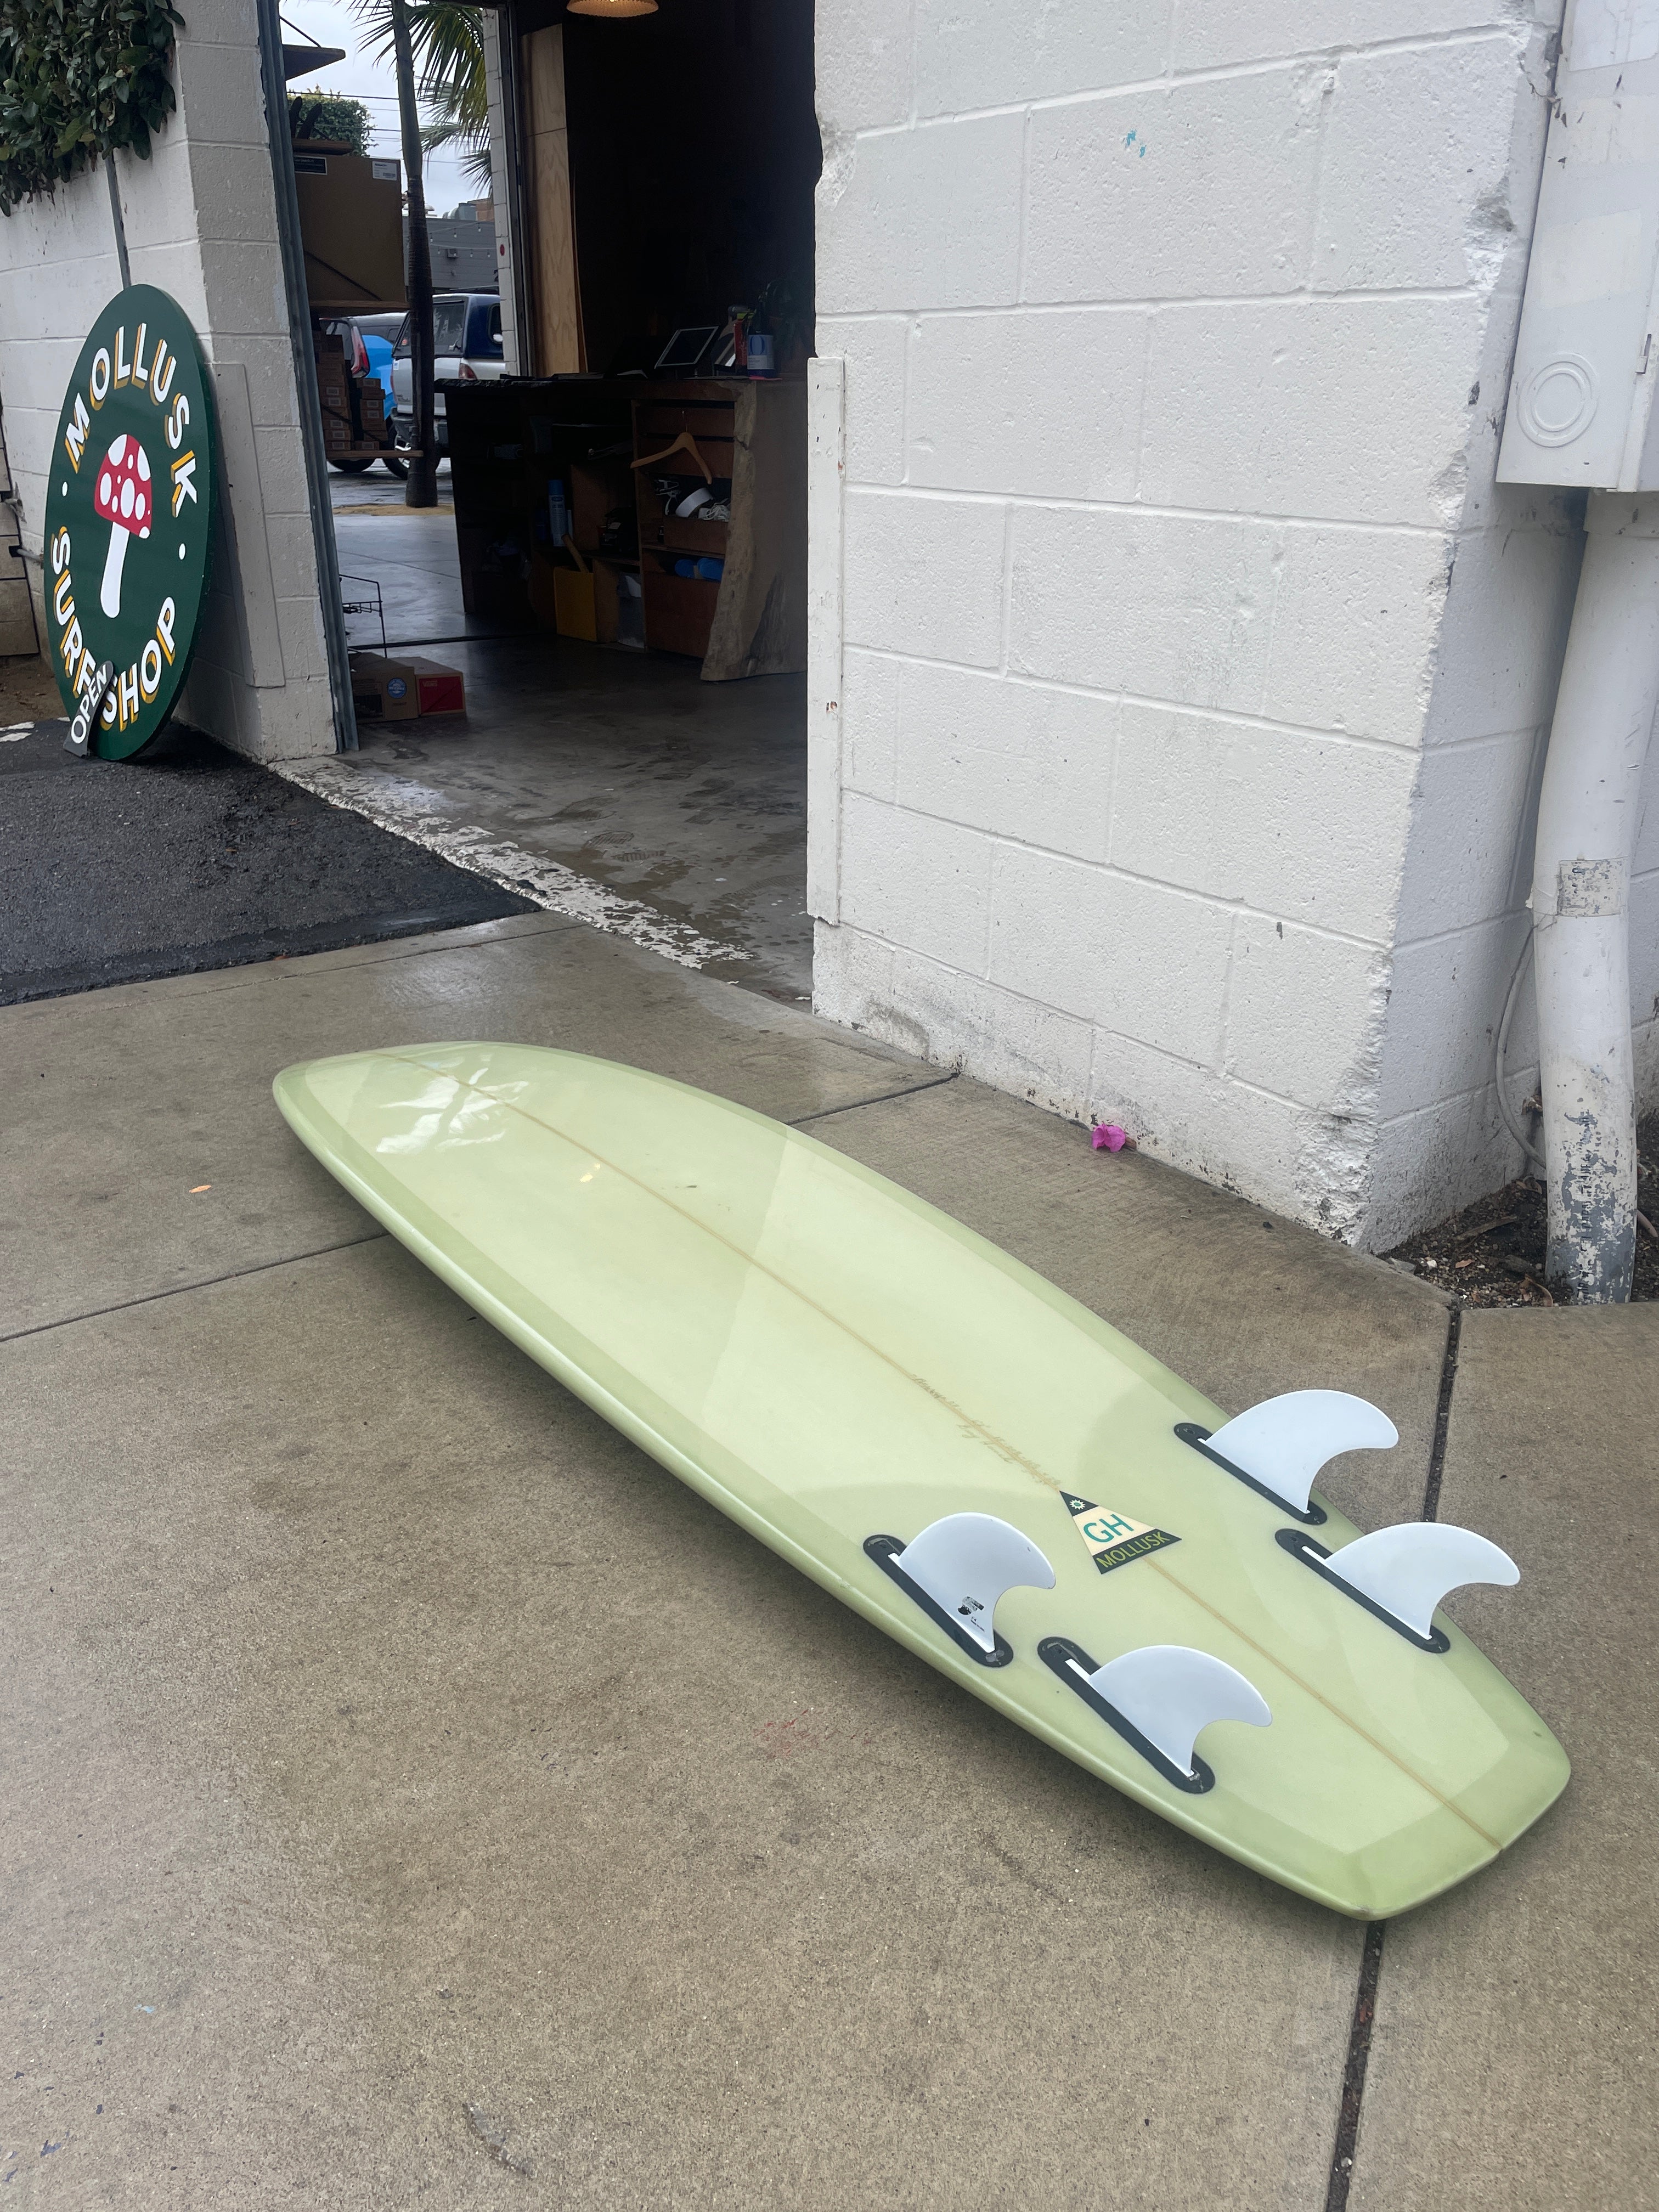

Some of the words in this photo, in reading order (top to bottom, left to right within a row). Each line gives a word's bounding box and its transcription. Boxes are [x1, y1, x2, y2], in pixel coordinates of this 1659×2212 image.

[65, 323, 197, 517] MOLLUSK
[51, 526, 97, 698] SURF
[100, 596, 176, 732] SHOP
[71, 664, 109, 743] OPEN
[1083, 1514, 1135, 1543] GH
[1097, 1531, 1170, 1568] MOLLUSK
